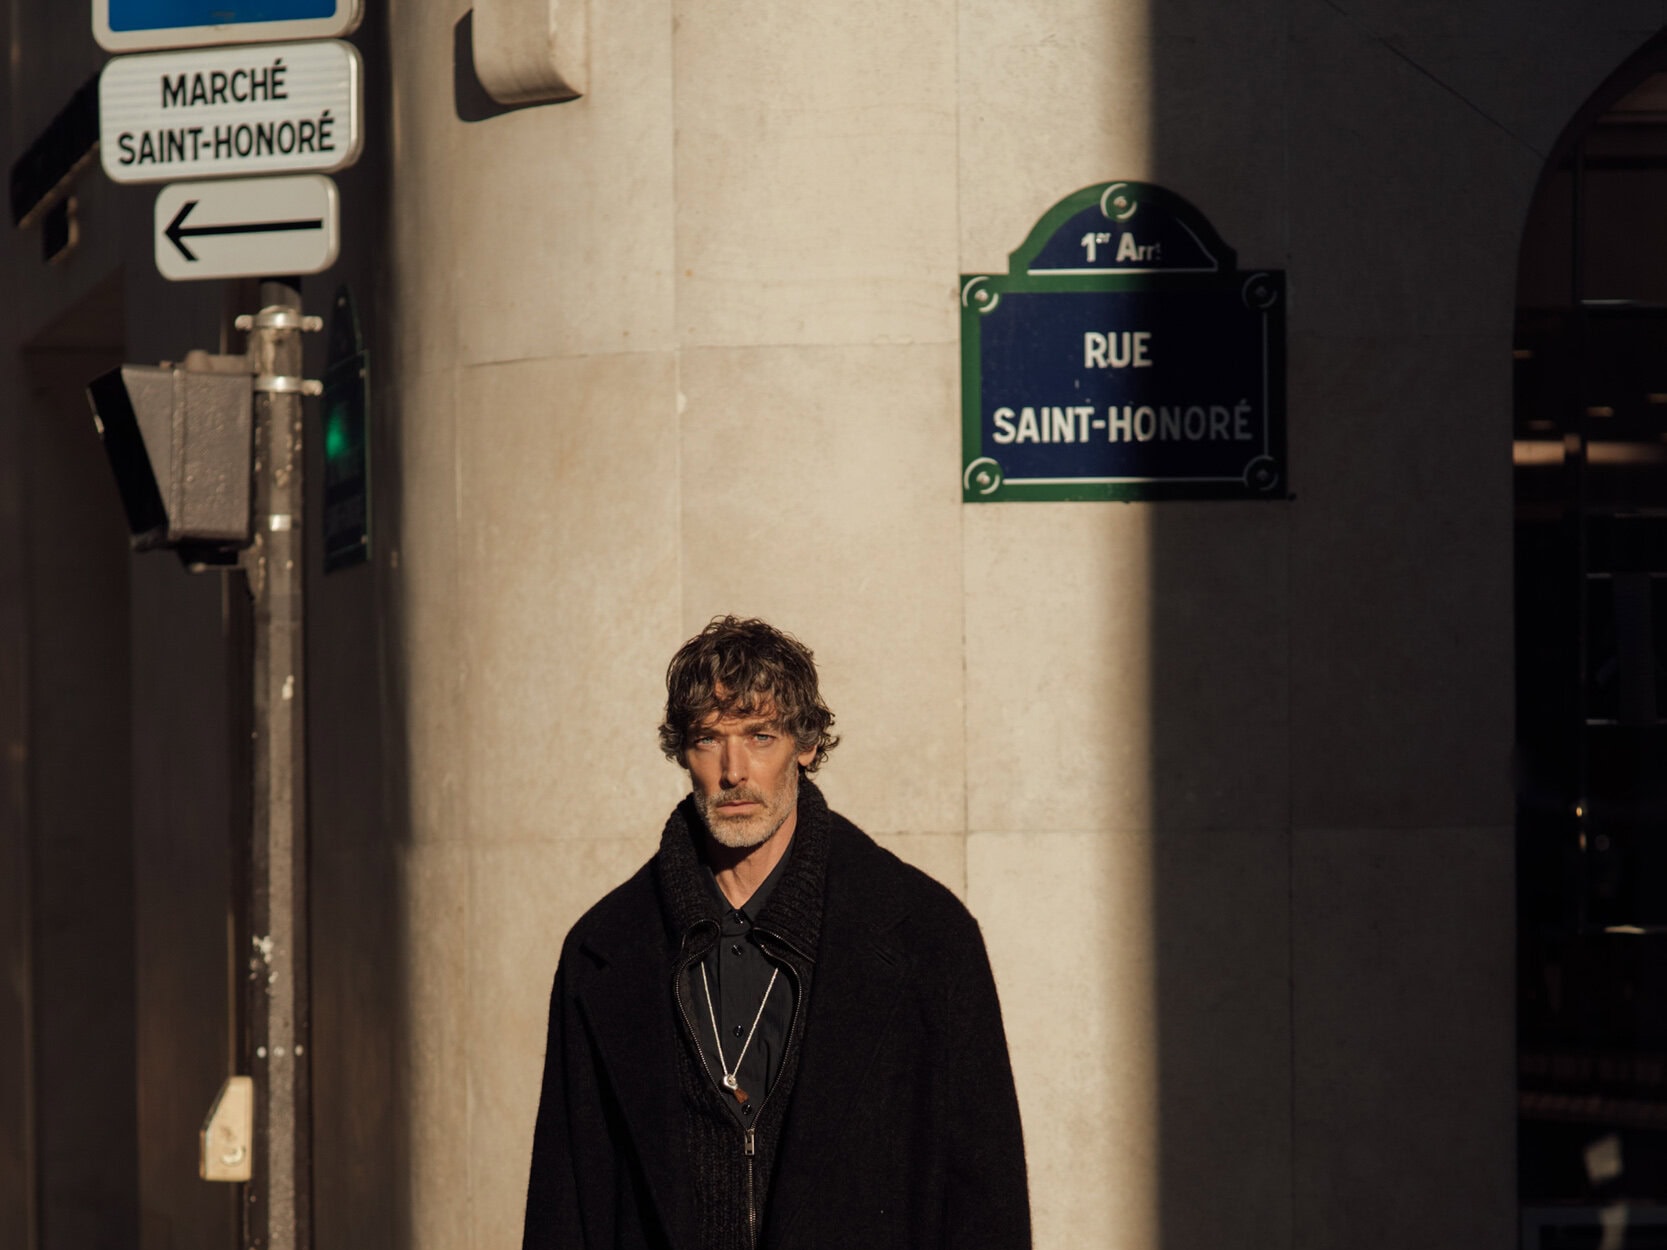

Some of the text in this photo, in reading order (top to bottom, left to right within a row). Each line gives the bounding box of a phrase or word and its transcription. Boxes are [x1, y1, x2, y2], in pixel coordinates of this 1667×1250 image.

[162, 59, 288, 108] MARCHÉ
[118, 110, 334, 166] SAINT-HONORÉ
[1083, 331, 1154, 369] RUE
[992, 398, 1253, 444] SAINT-HONORÉ
